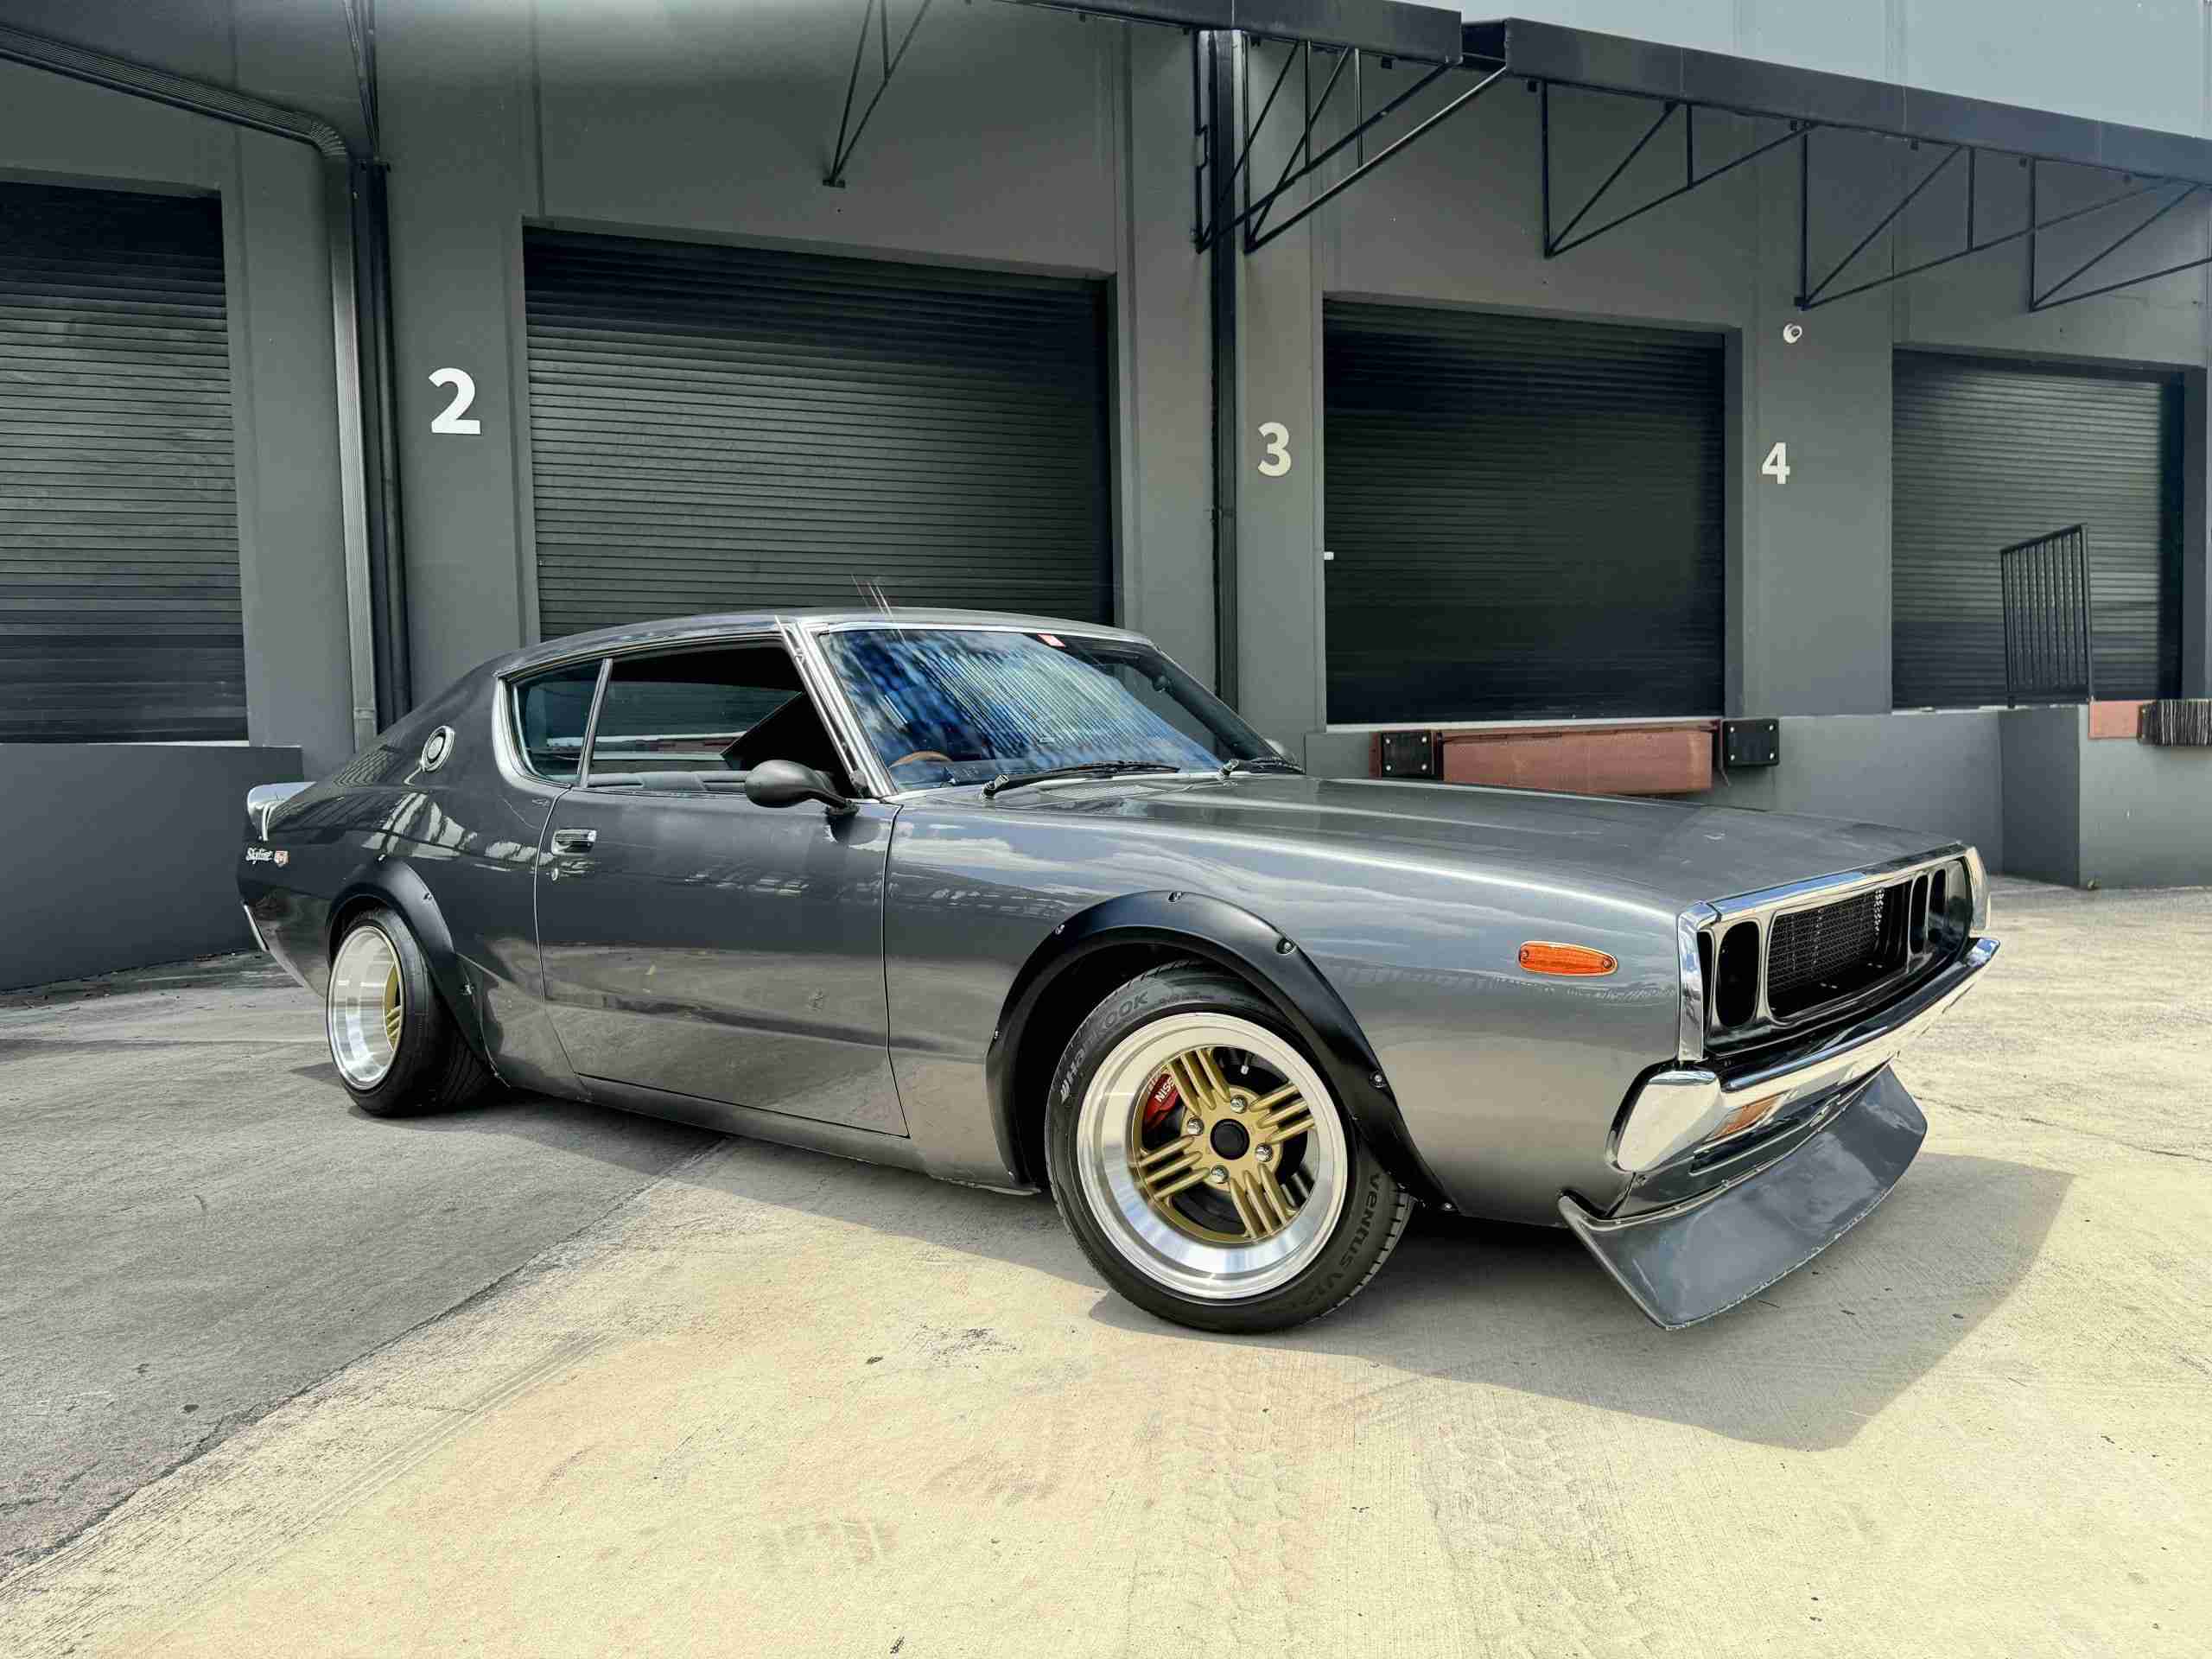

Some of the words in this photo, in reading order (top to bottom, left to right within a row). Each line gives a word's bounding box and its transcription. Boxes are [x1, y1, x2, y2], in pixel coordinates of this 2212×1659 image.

[428, 367, 480, 434] 2
[1257, 422, 1291, 476] 3
[1762, 442, 1790, 484] 4
[1066, 991, 1148, 1085] HAKOOK
[1154, 1077, 1176, 1103] NISS
